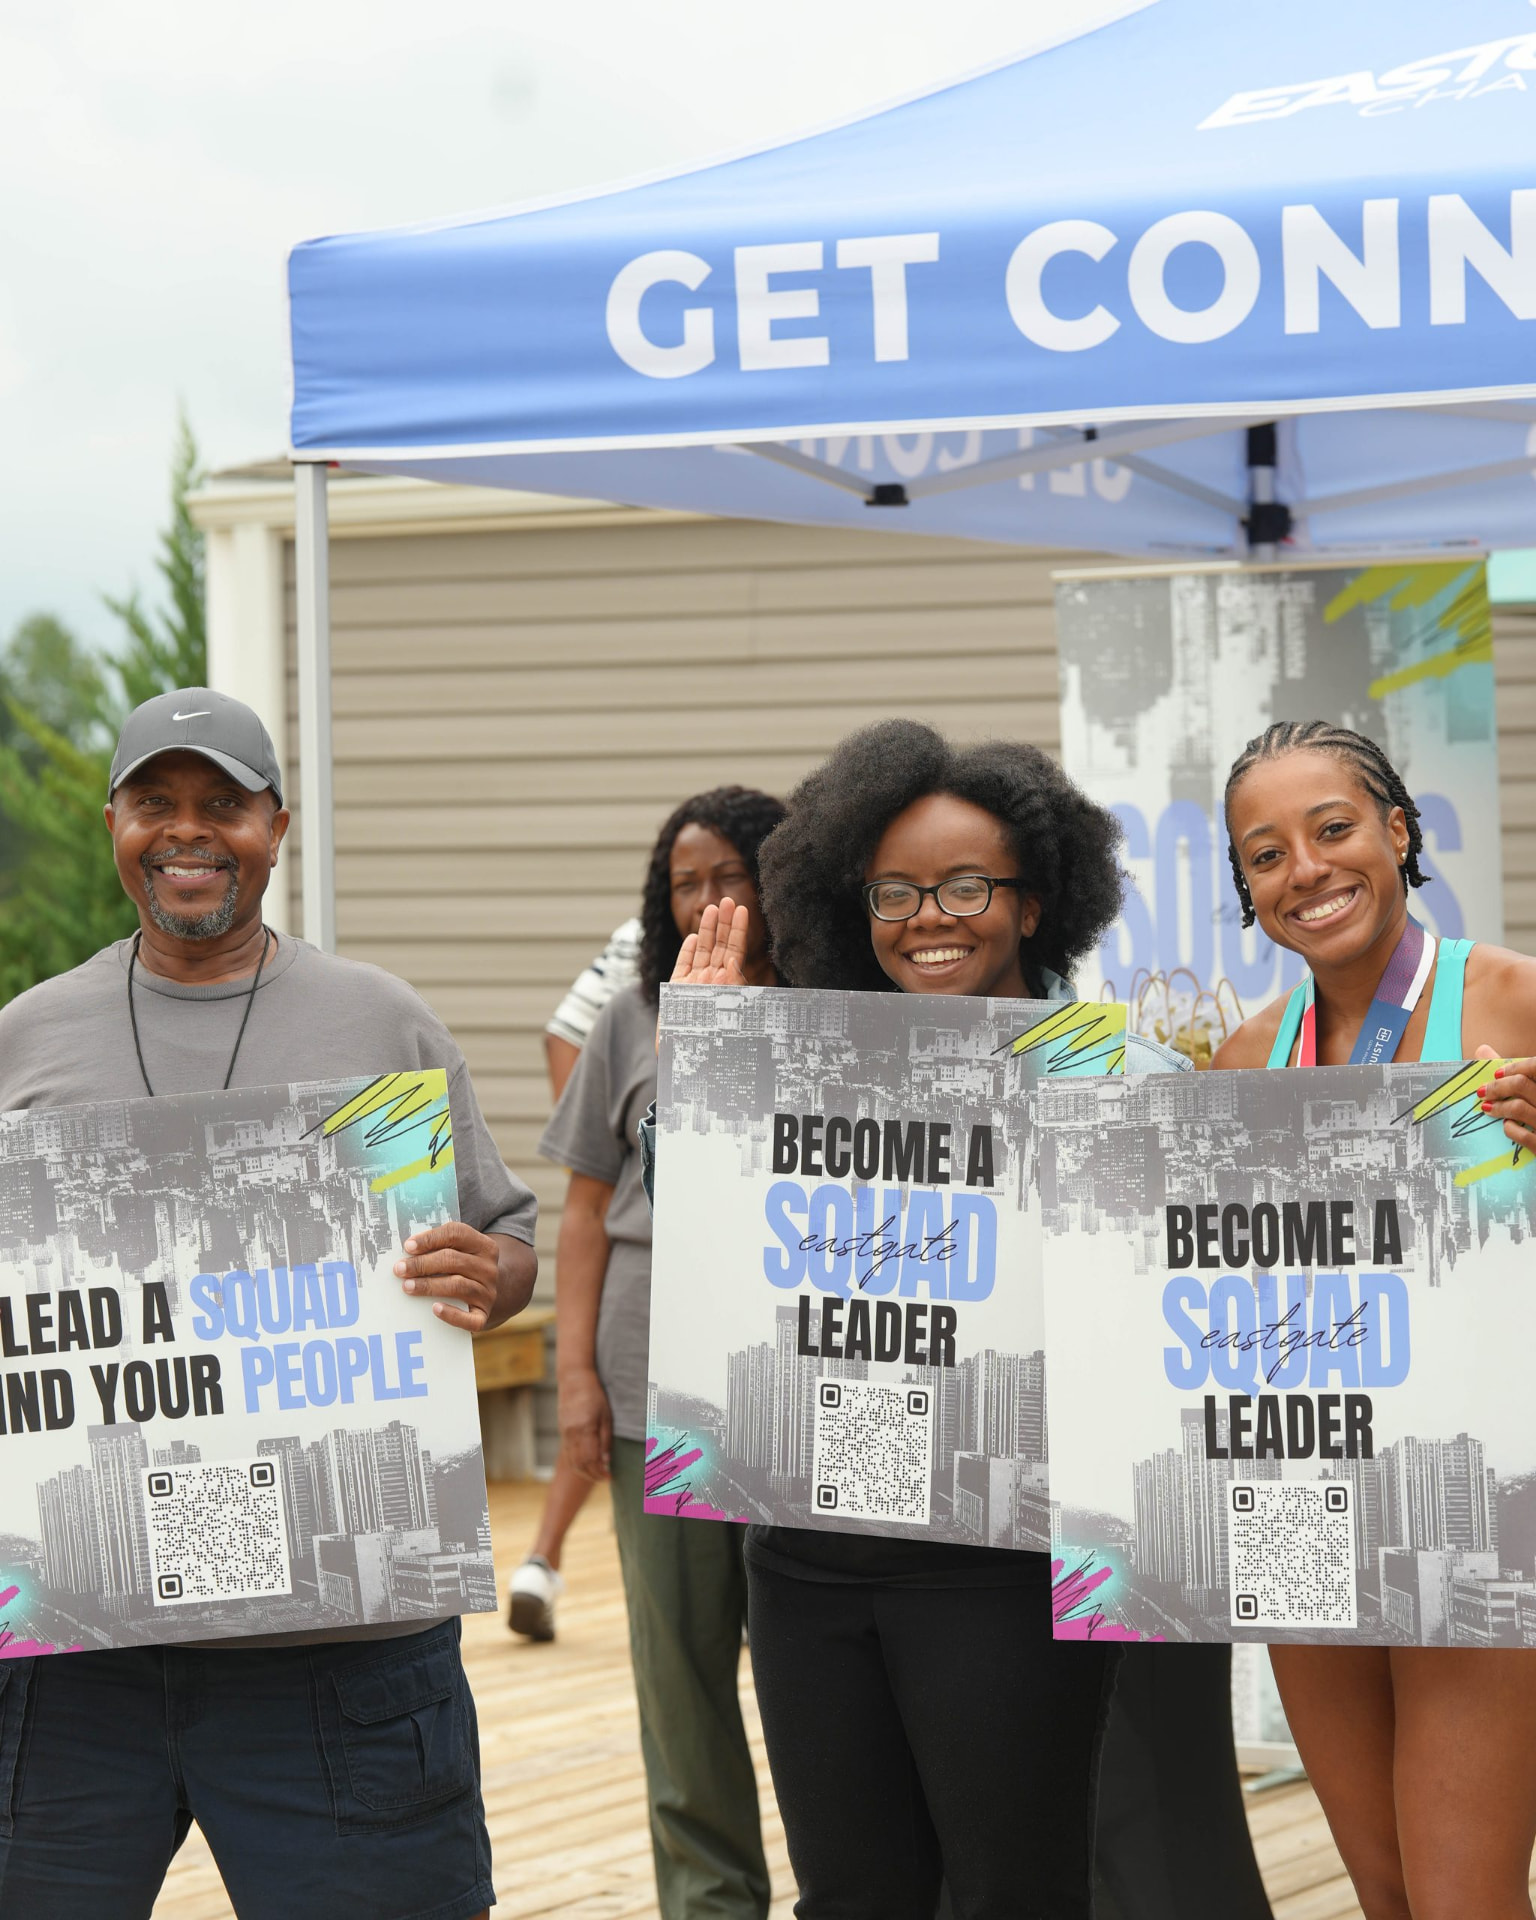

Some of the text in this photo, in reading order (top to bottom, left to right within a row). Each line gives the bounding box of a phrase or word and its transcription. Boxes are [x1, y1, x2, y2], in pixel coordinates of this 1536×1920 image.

[606, 188, 1536, 379] GET CONN
[772, 1113, 995, 1187] BECOME A
[763, 1181, 997, 1303] SQUAD
[798, 1215, 959, 1290] eastgate
[1166, 1199, 1403, 1269] BECOME A
[0, 1261, 360, 1358] LEAD A SQUAD
[797, 1294, 957, 1367] LEADER
[1162, 1273, 1411, 1399] SQUAD
[1200, 1302, 1369, 1384] eastgate
[89, 1353, 225, 1426] YOUR
[240, 1330, 429, 1414] PEOPLE
[1204, 1394, 1374, 1460] LEADER
